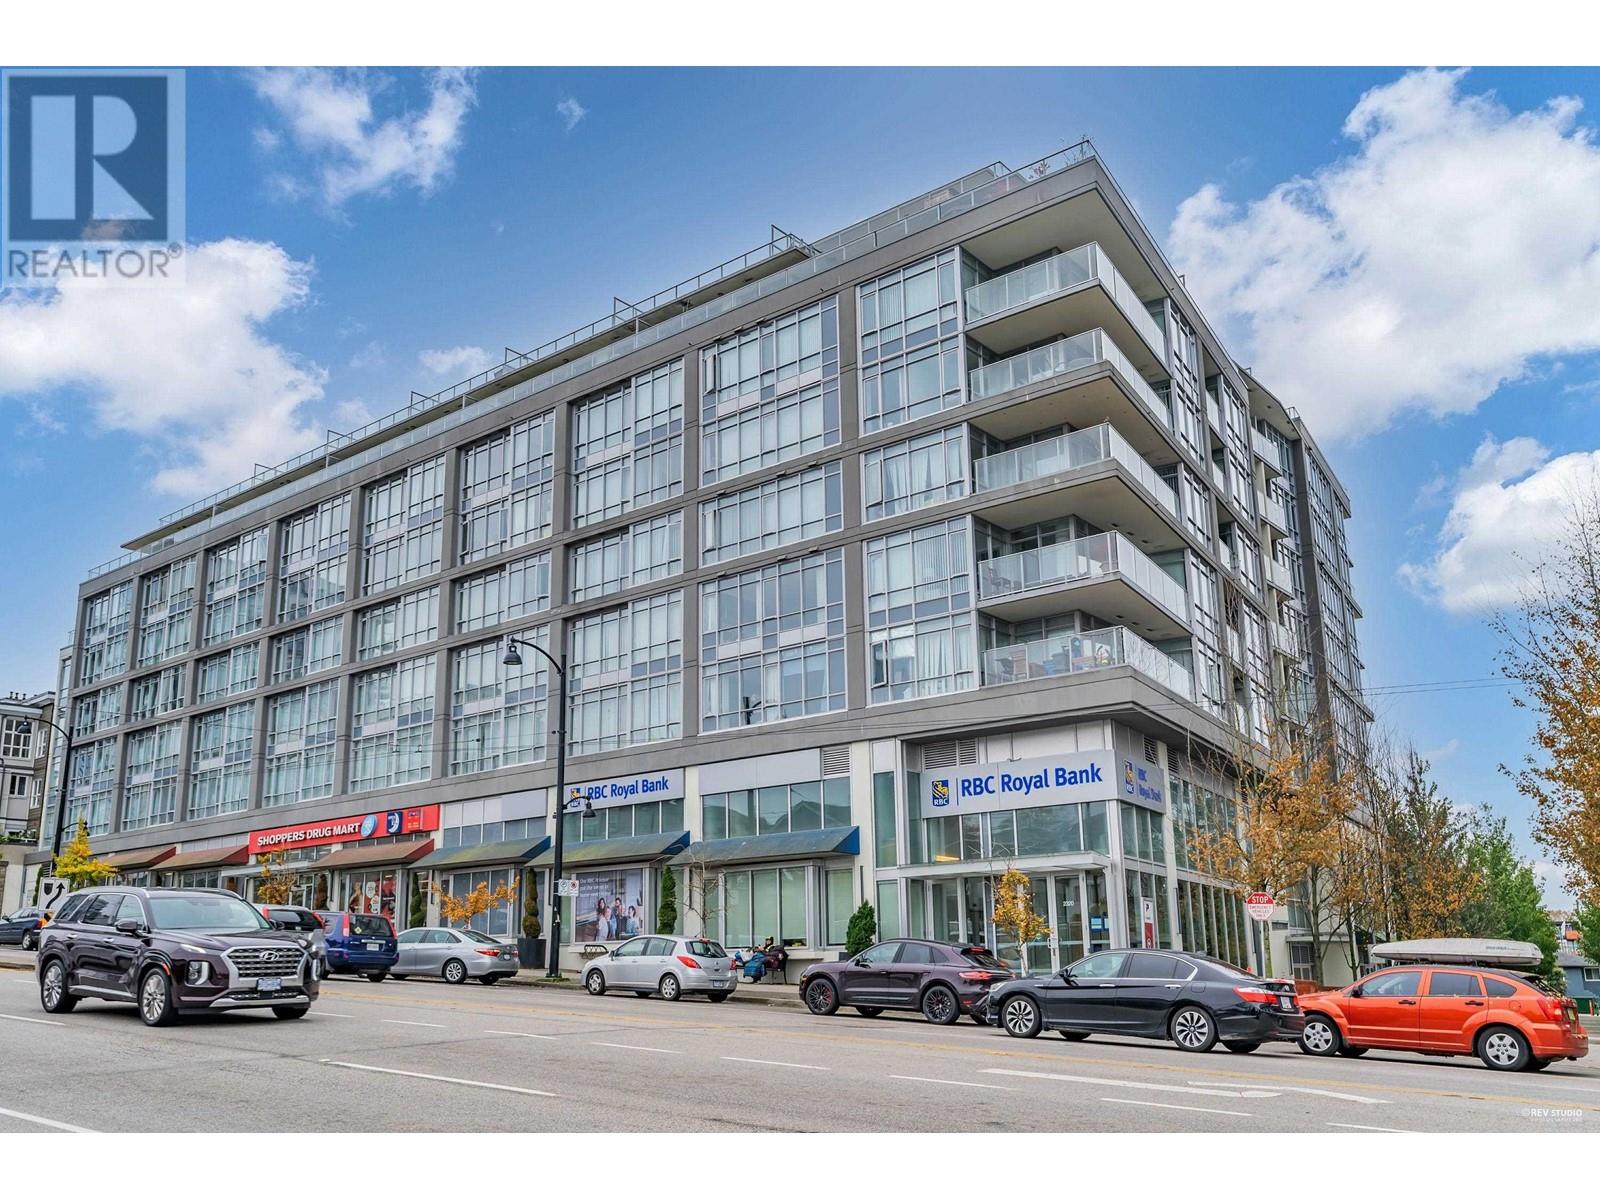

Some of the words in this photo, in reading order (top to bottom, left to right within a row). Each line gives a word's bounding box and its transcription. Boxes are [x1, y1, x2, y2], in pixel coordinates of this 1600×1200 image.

[587, 785, 608, 800] RBC
[610, 780, 639, 799] Royal
[641, 776, 669, 793] Bank
[961, 775, 996, 797] RBC
[1001, 768, 1050, 795] Royal
[1055, 763, 1103, 787] Bank
[933, 798, 948, 806] RBC
[257, 831, 306, 847] SHOPPERS
[306, 826, 332, 840] DRUG
[332, 822, 361, 836] MART
[1251, 896, 1269, 904] STOP
